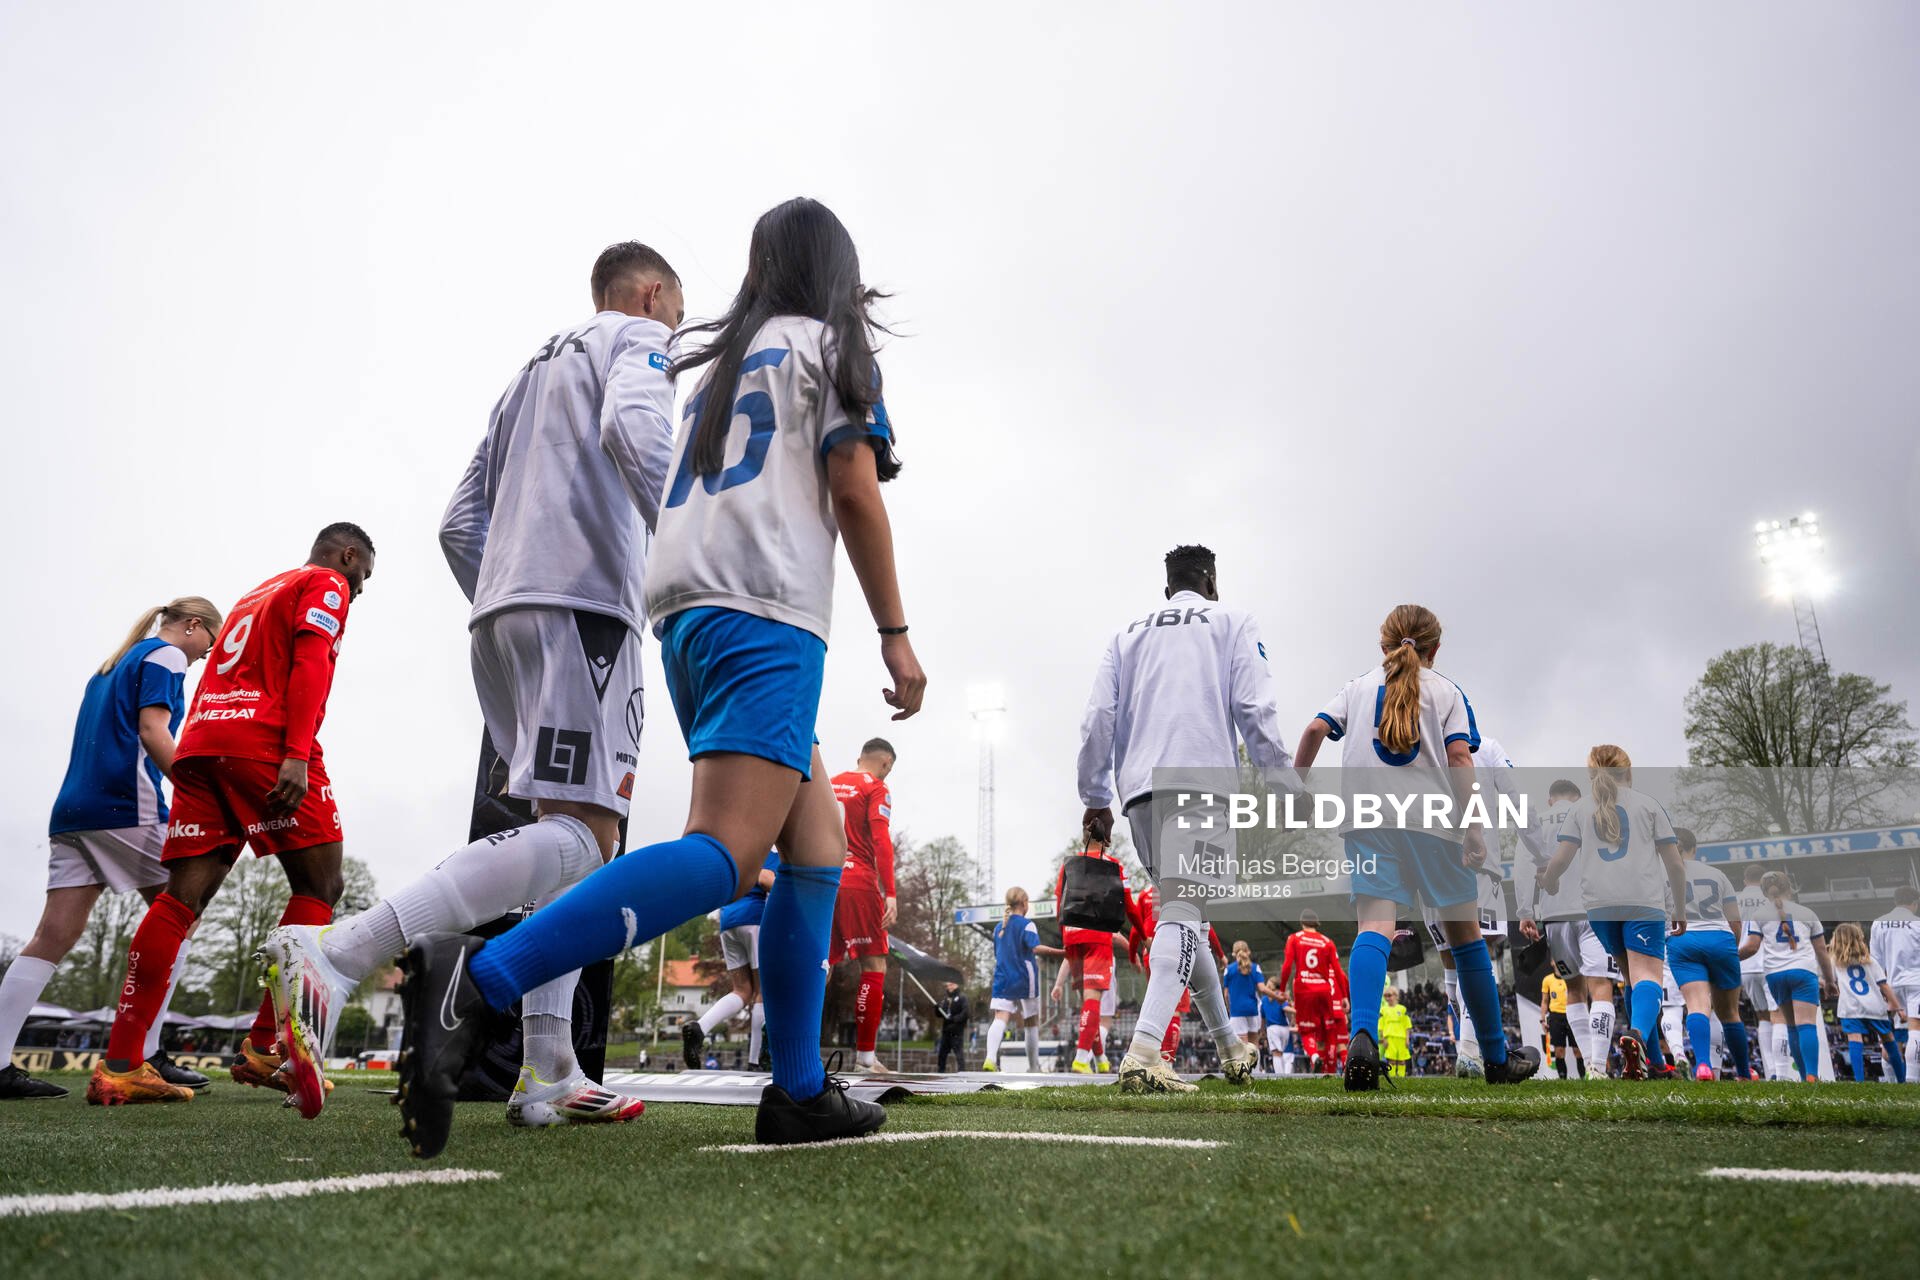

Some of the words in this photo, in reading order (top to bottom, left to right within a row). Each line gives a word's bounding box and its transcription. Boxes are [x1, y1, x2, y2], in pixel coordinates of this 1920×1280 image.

[1127, 607, 1213, 634] HBK
[217, 614, 254, 675] 9
[247, 816, 299, 835] RAVEMA
[1728, 837, 1851, 861] HIMLEN
[1775, 913, 1800, 943] 4
[1880, 919, 1913, 930] HBK
[1305, 948, 1319, 969] 6
[1846, 964, 1870, 996] 8
